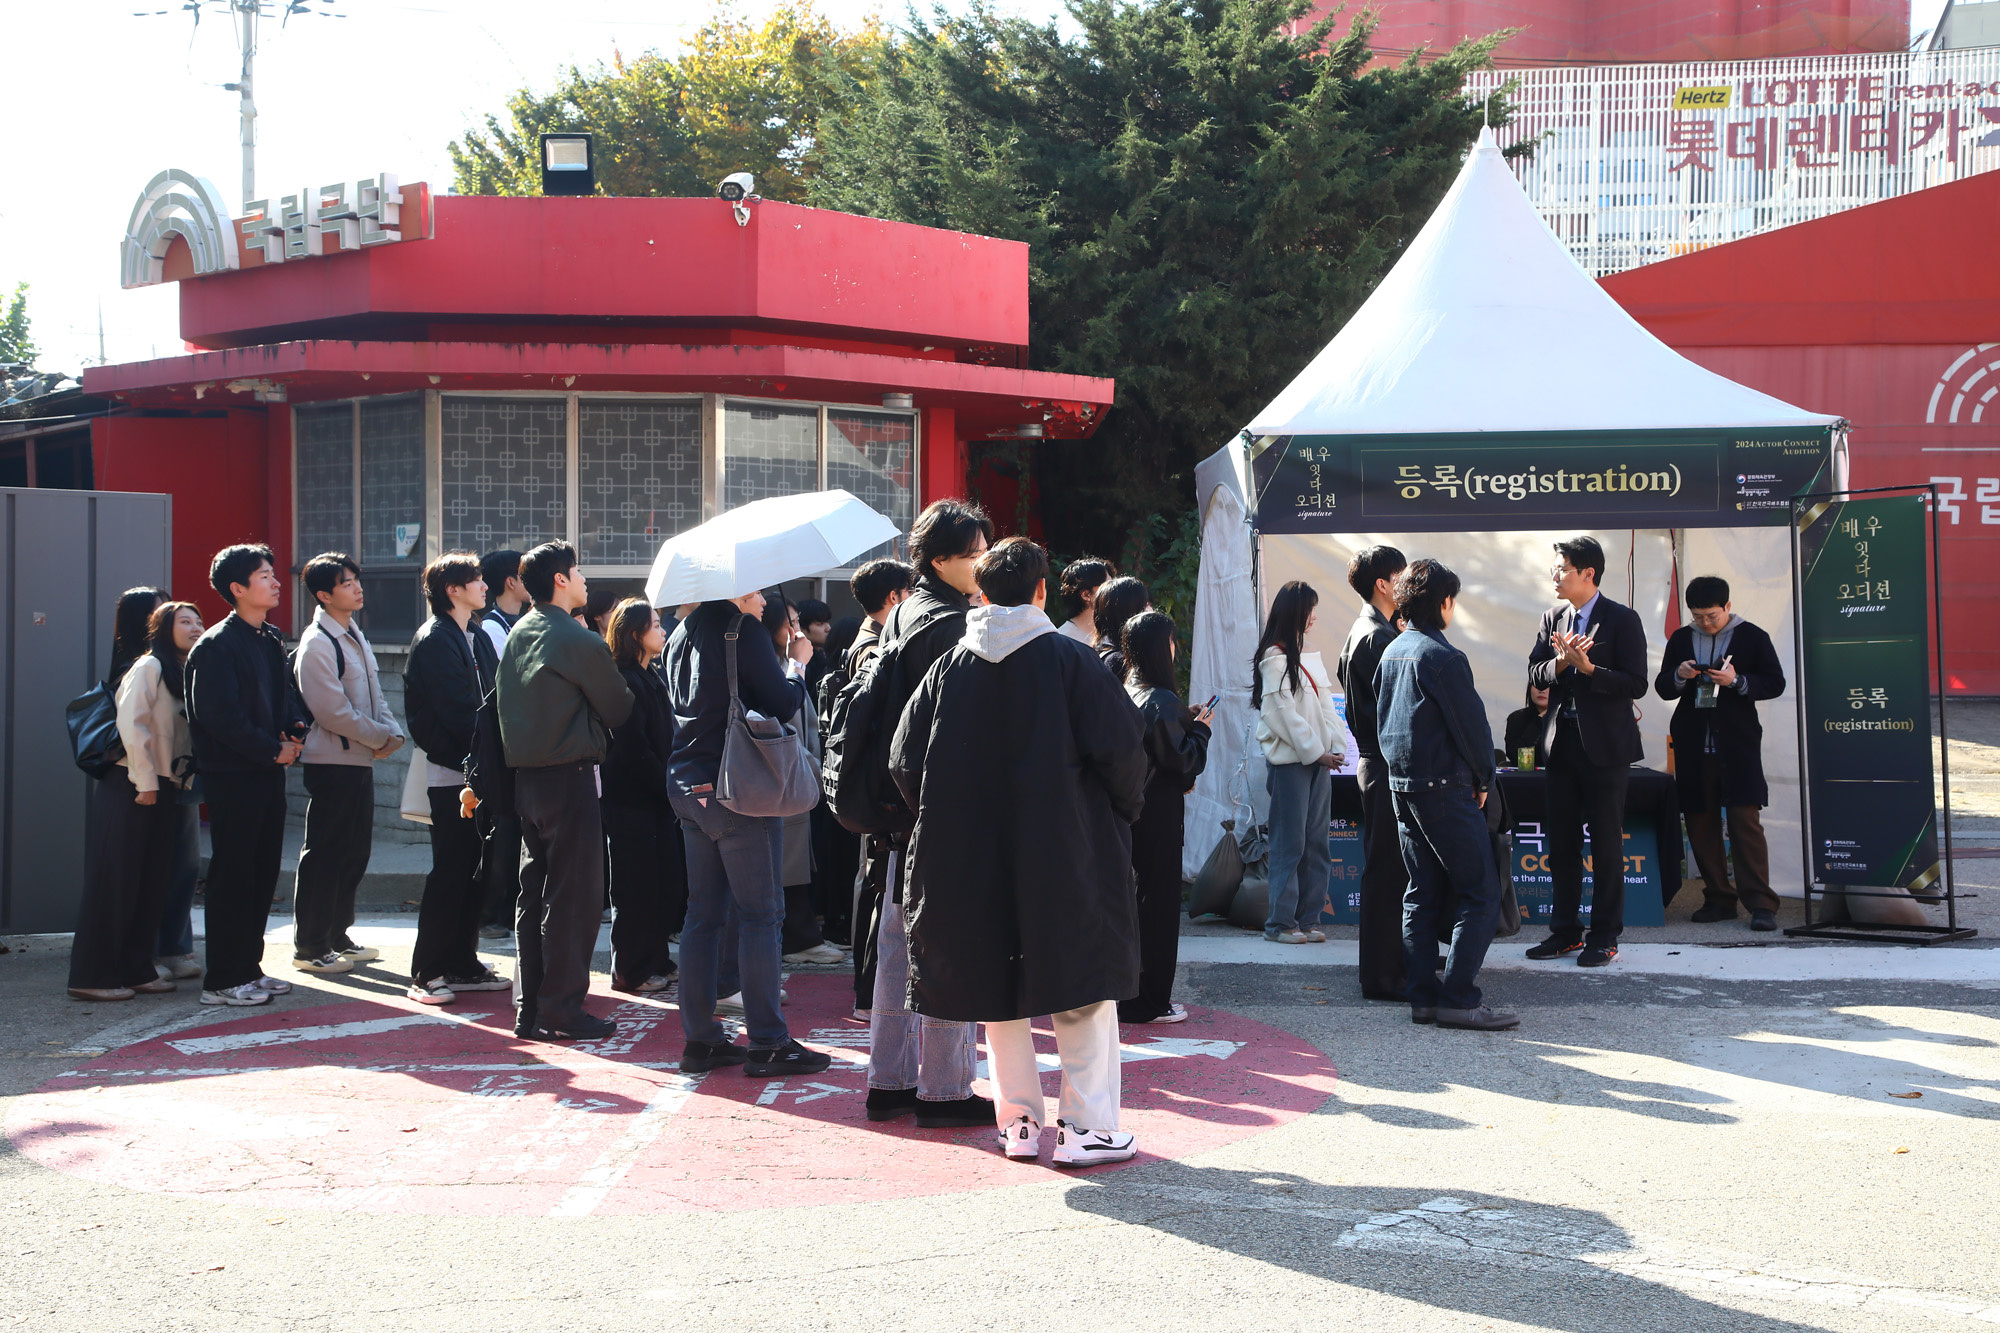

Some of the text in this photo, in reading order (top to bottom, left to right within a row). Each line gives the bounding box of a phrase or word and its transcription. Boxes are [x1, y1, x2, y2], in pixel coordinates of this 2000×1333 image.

[1680, 90, 1726, 104] Hertz
[1742, 76, 1884, 107] LOTTE
[1666, 107, 1970, 173] 롯데렌터카
[242, 172, 404, 264] 국립극단
[1735, 440, 1754, 449] 2024
[1299, 446, 1331, 462] 배우
[1393, 463, 1682, 501] 등록(registration)
[1295, 493, 1337, 508] 오디션
[1297, 510, 1333, 520] signature
[1840, 515, 1883, 538] 배우
[1836, 580, 1891, 601] 오디션
[1840, 604, 1886, 617] signature
[1846, 687, 1889, 709] 등록
[1824, 718, 1914, 733] (registration)
[1521, 874, 1536, 882] the
[1623, 875, 1648, 883] heart
